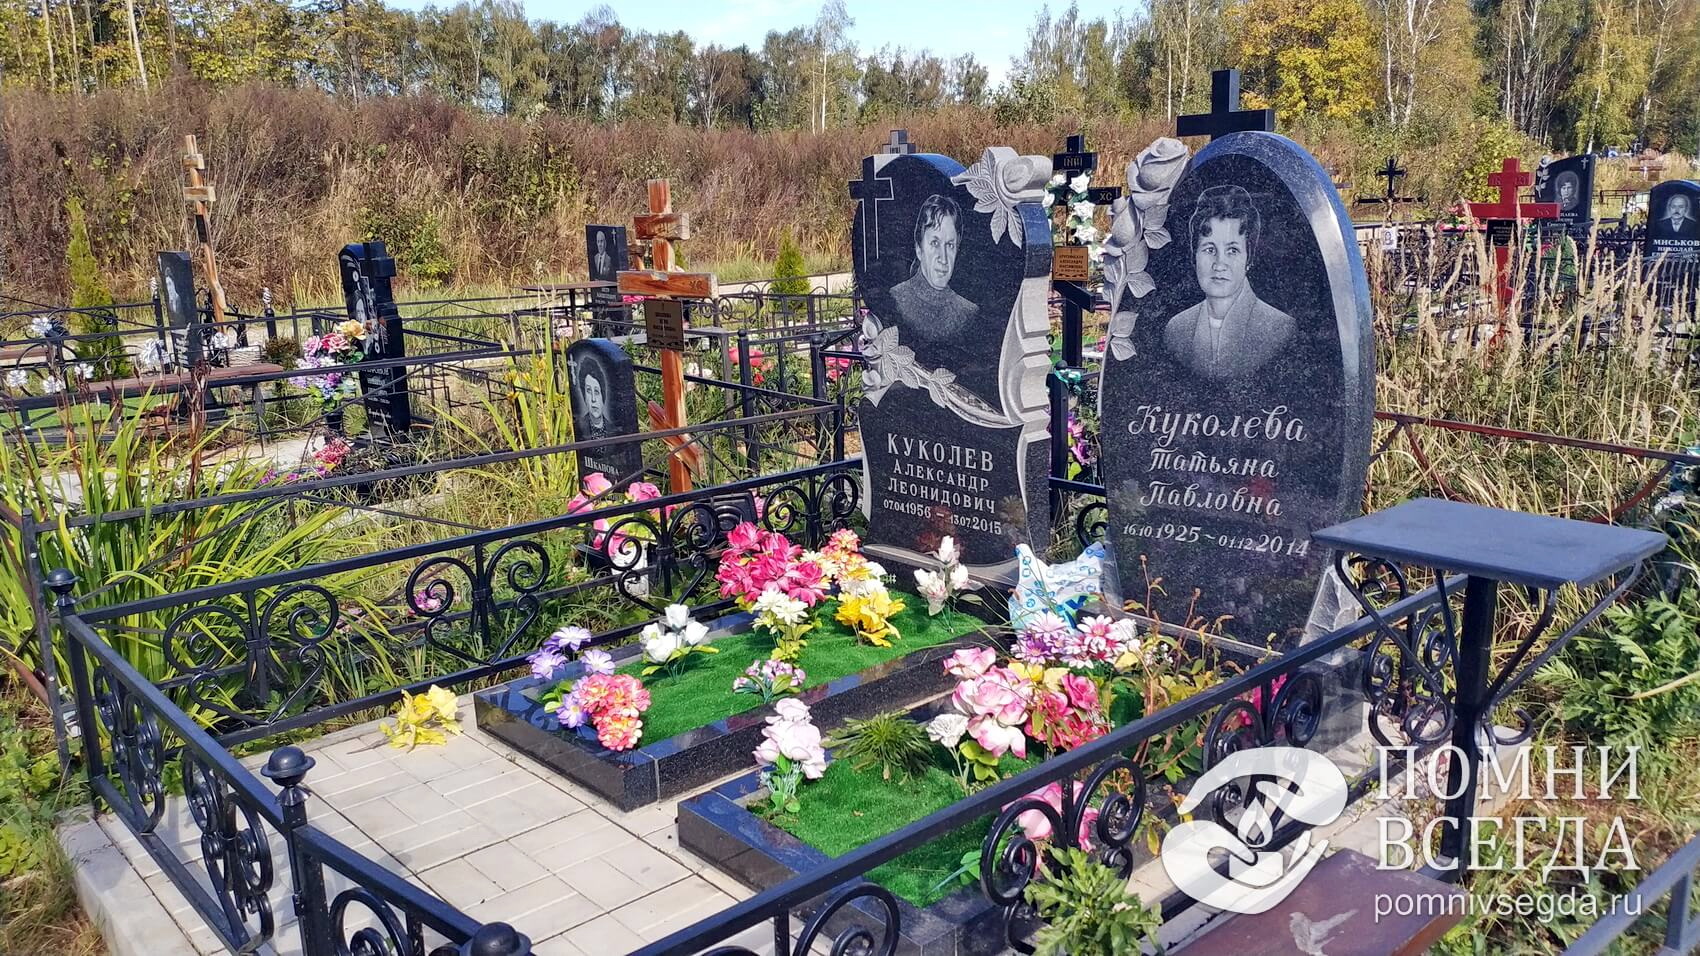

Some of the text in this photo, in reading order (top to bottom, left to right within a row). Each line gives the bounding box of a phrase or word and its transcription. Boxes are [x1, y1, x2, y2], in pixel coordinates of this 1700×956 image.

[1652, 239, 1700, 247] МИСЬКОВ
[1127, 404, 1308, 448] Куколева
[887, 432, 994, 472] КУКОЛЕВ
[1148, 447, 1280, 478] Татьяна
[893, 458, 990, 493] АЛЕКСАНДР
[887, 477, 996, 514] ЛЕОНИДОВИЧ
[1139, 480, 1283, 517] Павловна
[1123, 523, 1202, 543] 16.10.1925
[1218, 534, 1310, 557] 01.12.2014
